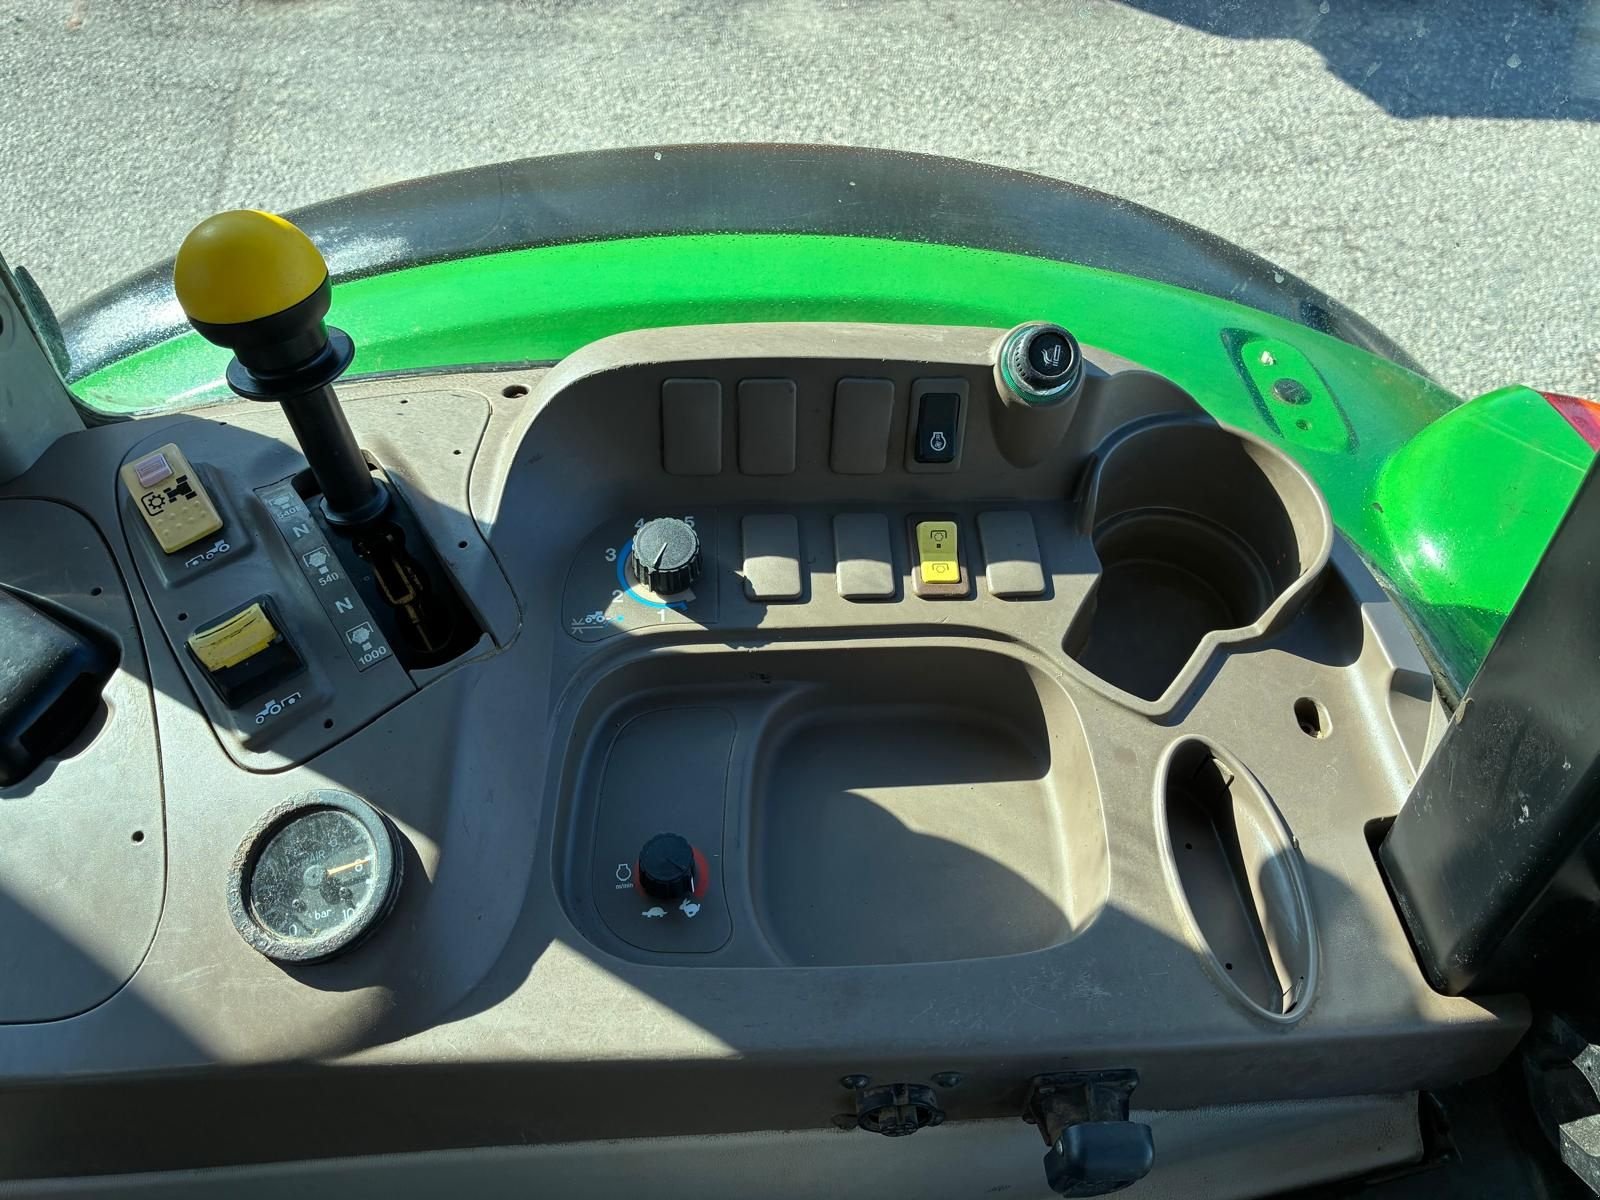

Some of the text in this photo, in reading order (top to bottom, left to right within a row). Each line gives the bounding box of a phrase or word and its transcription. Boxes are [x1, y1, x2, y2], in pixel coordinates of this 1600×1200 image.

[634, 518, 645, 529] 4
[684, 516, 695, 528] 5
[292, 523, 310, 538] N
[605, 548, 616, 561] 3
[318, 572, 339, 586] 540
[612, 590, 624, 603] 2
[334, 597, 354, 613] N
[657, 609, 665, 622] 1
[358, 646, 387, 665] 1000
[310, 850, 326, 861] AIR
[314, 909, 332, 920] bar
[342, 907, 355, 921] 10
[289, 924, 297, 937] 0
